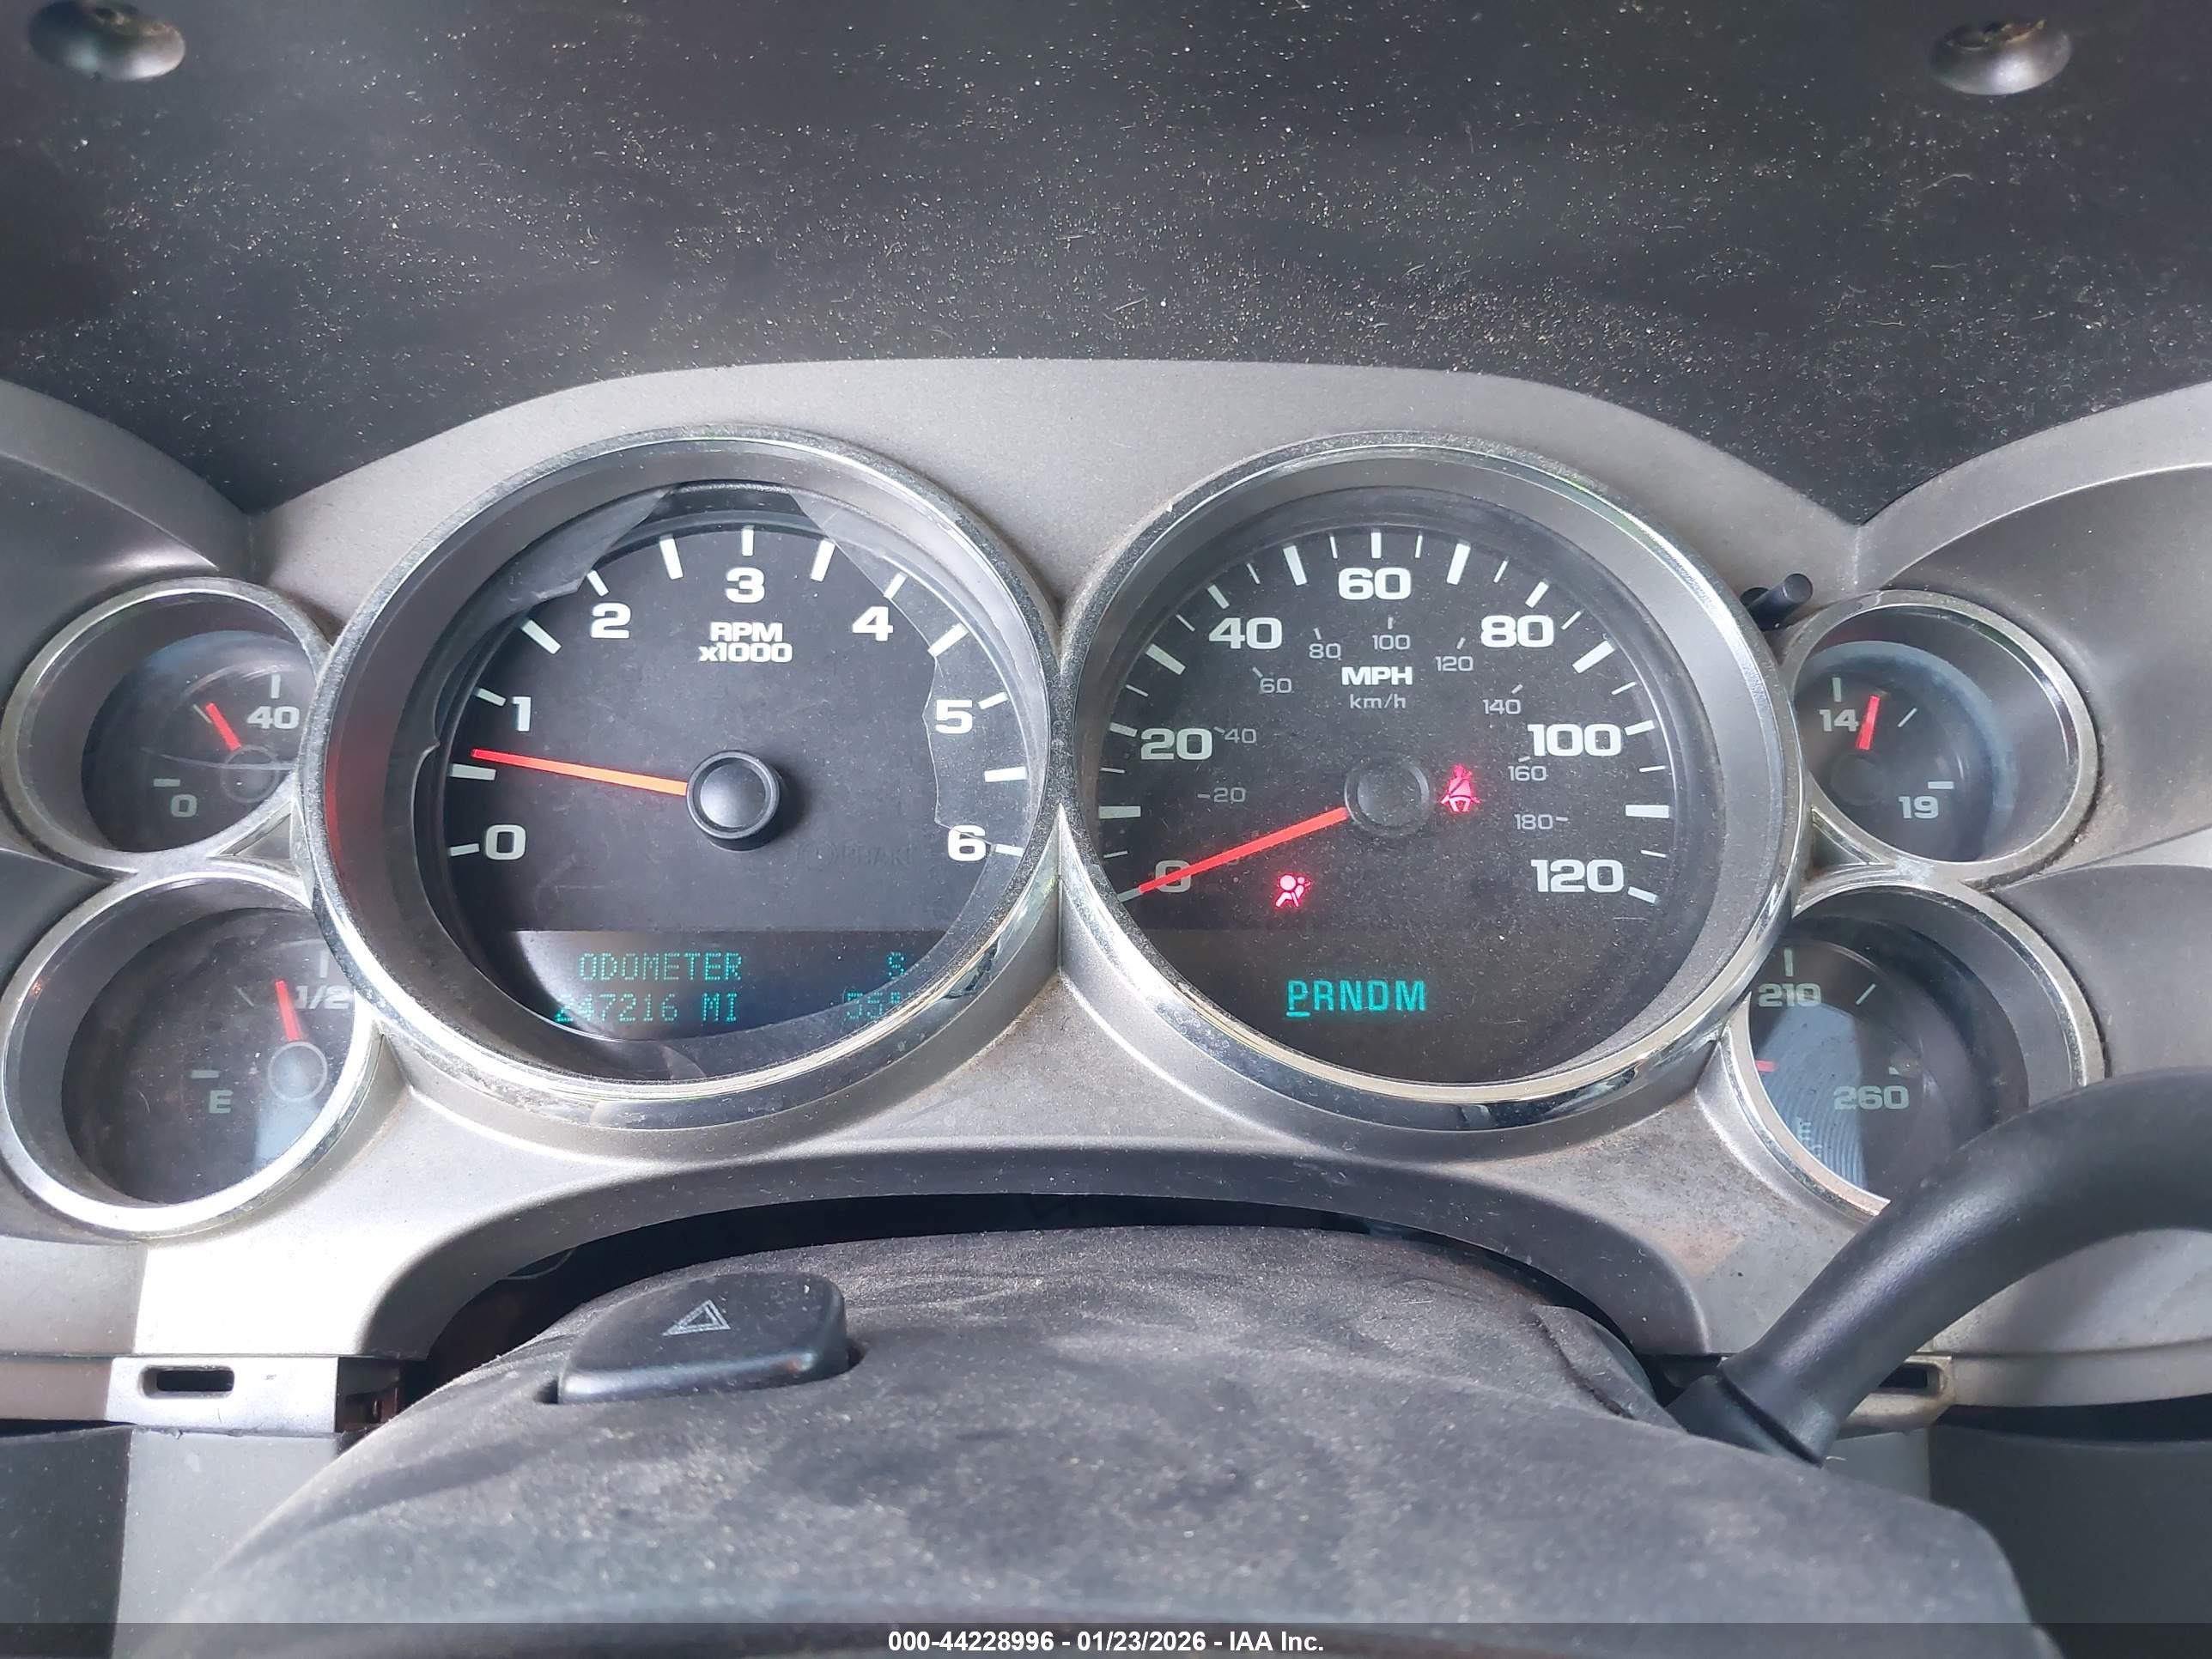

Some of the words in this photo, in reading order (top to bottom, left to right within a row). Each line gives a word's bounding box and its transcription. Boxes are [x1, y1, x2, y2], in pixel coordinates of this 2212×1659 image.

[726, 567, 764, 603] 3
[1338, 568, 1411, 599] 60
[591, 603, 631, 638] 2
[710, 622, 783, 642] RPM
[852, 606, 893, 641] 4
[1481, 615, 1554, 647] 80
[1208, 617, 1282, 649] 40
[1372, 635, 1411, 650] 100
[698, 641, 793, 663] x1000
[1309, 643, 1341, 659] 80
[1341, 666, 1413, 685] MPH
[1435, 656, 1474, 672] 120
[1259, 678, 1291, 694] 60
[1350, 694, 1406, 708] km/h
[1482, 699, 1522, 714] 140
[246, 706, 300, 729] 40
[512, 696, 531, 731] 1
[935, 700, 973, 734] 5
[1819, 709, 1859, 732] 14
[1140, 728, 1212, 760] 20
[1224, 728, 1256, 744] 40
[1528, 723, 1621, 757] 100
[1508, 765, 1547, 781] 160
[170, 794, 198, 817] 0
[1213, 787, 1246, 802] 20
[1898, 796, 1938, 818] 19
[1515, 814, 1553, 830] 180
[485, 824, 526, 860] 0
[948, 825, 986, 861] 6
[1155, 860, 1192, 893] 0
[1530, 860, 1624, 893] 120
[579, 952, 743, 981] ODOMETER
[295, 985, 351, 1010] 1/2
[1286, 979, 1426, 1012] PRNDM
[1759, 982, 1821, 1007] 210
[554, 993, 678, 1022] 247216
[701, 993, 737, 1022] MI
[209, 1090, 233, 1114] E
[1833, 1085, 1909, 1109] 260
